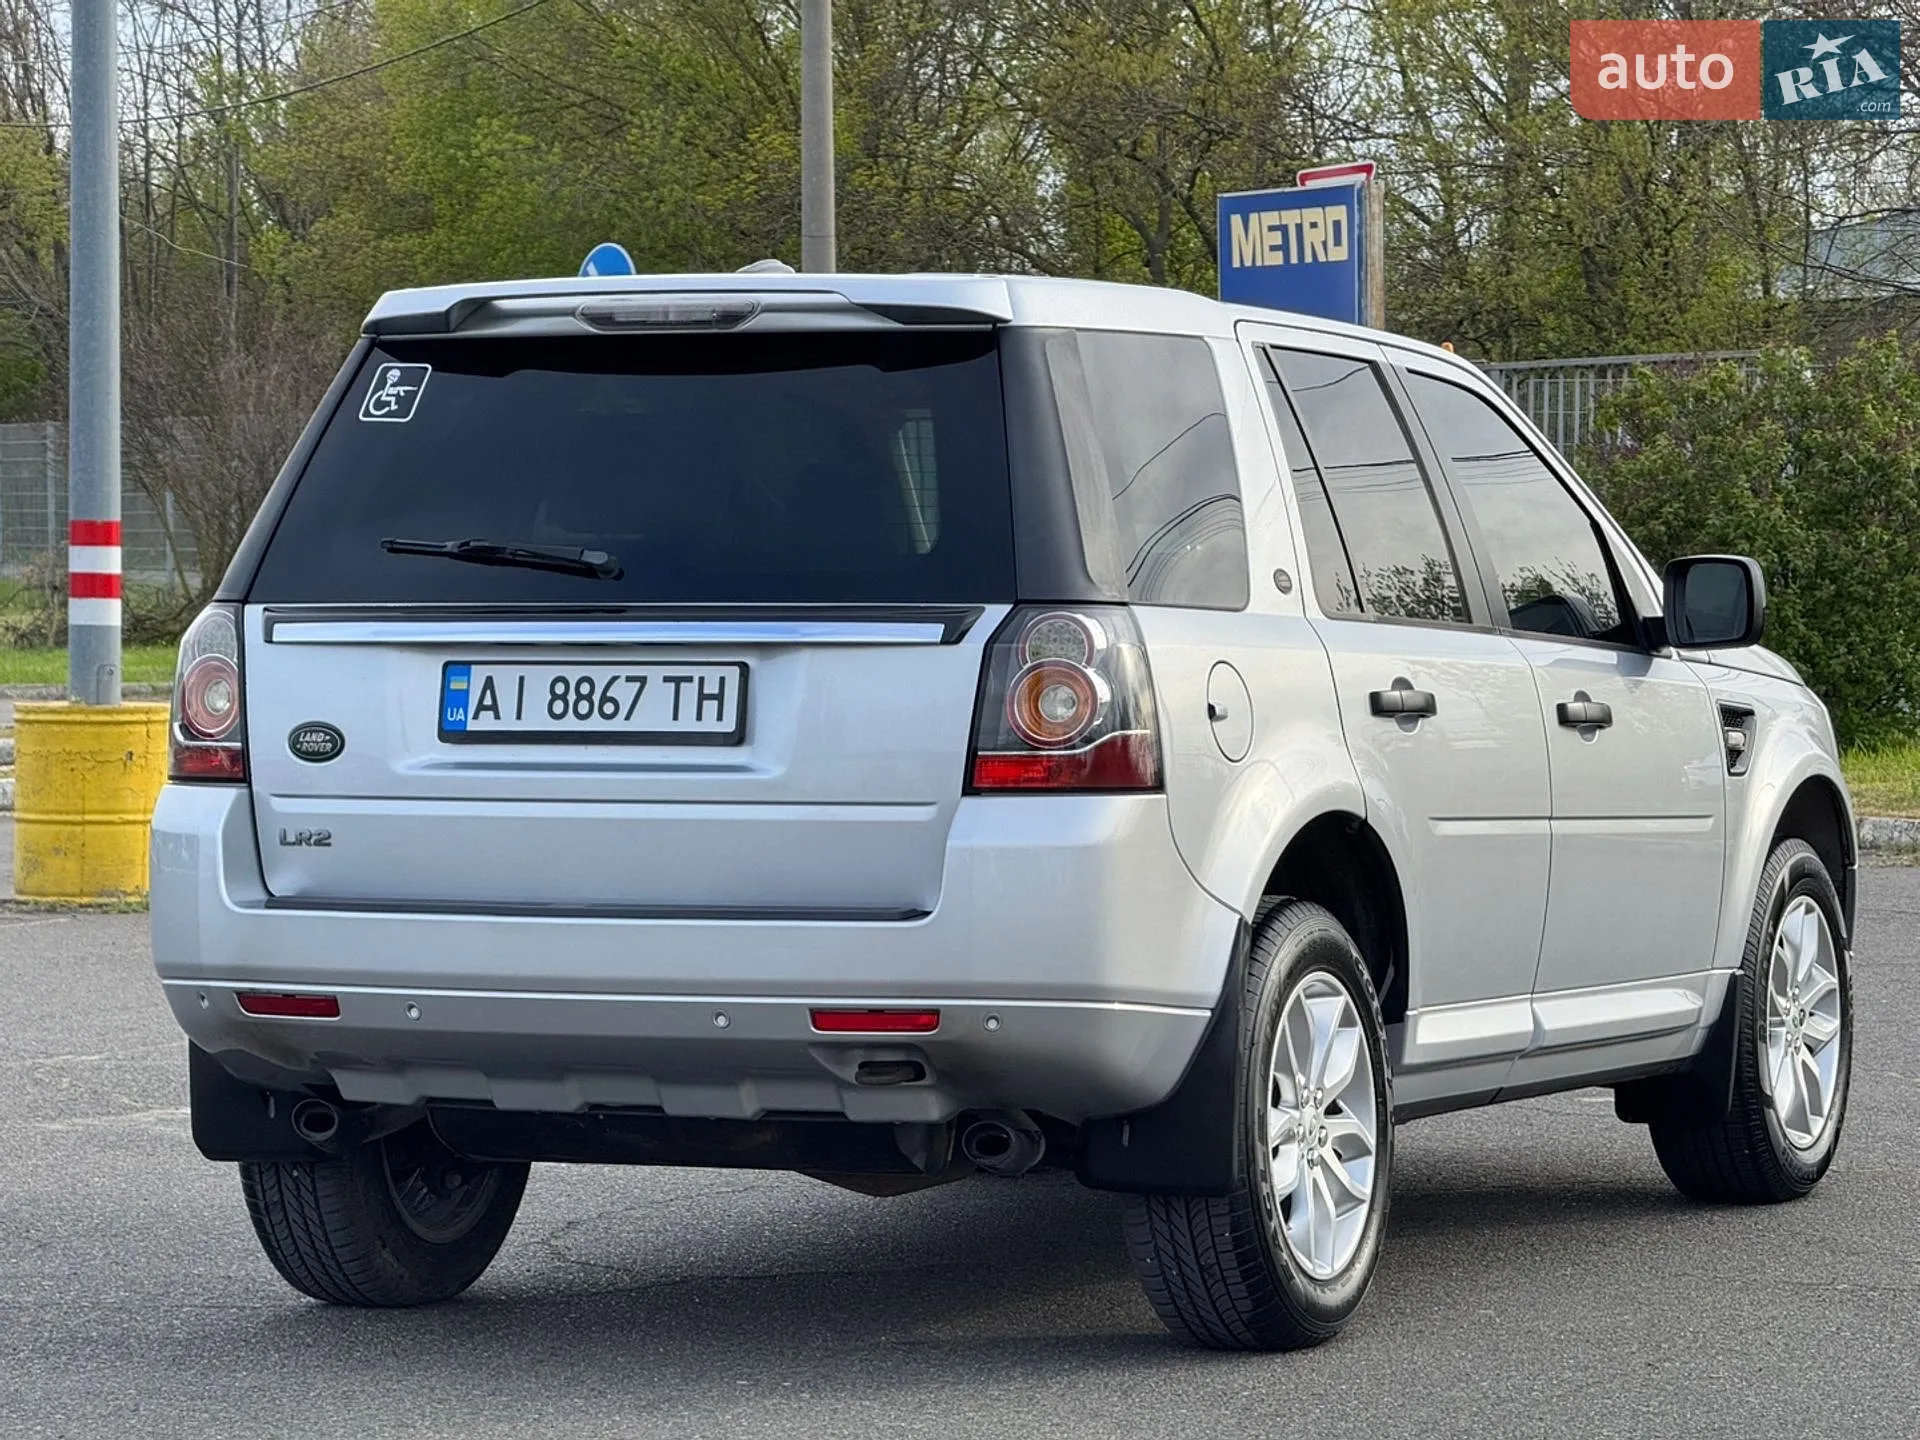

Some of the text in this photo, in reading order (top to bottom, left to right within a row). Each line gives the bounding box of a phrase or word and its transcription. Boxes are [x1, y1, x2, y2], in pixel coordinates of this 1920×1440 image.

[1230, 205, 1348, 268] METRO
[547, 675, 648, 721] 8867
[662, 675, 726, 722] TH
[447, 708, 465, 721] UA
[299, 731, 324, 742] LAND
[301, 742, 332, 753] ROVER
[279, 827, 332, 848] LR2
